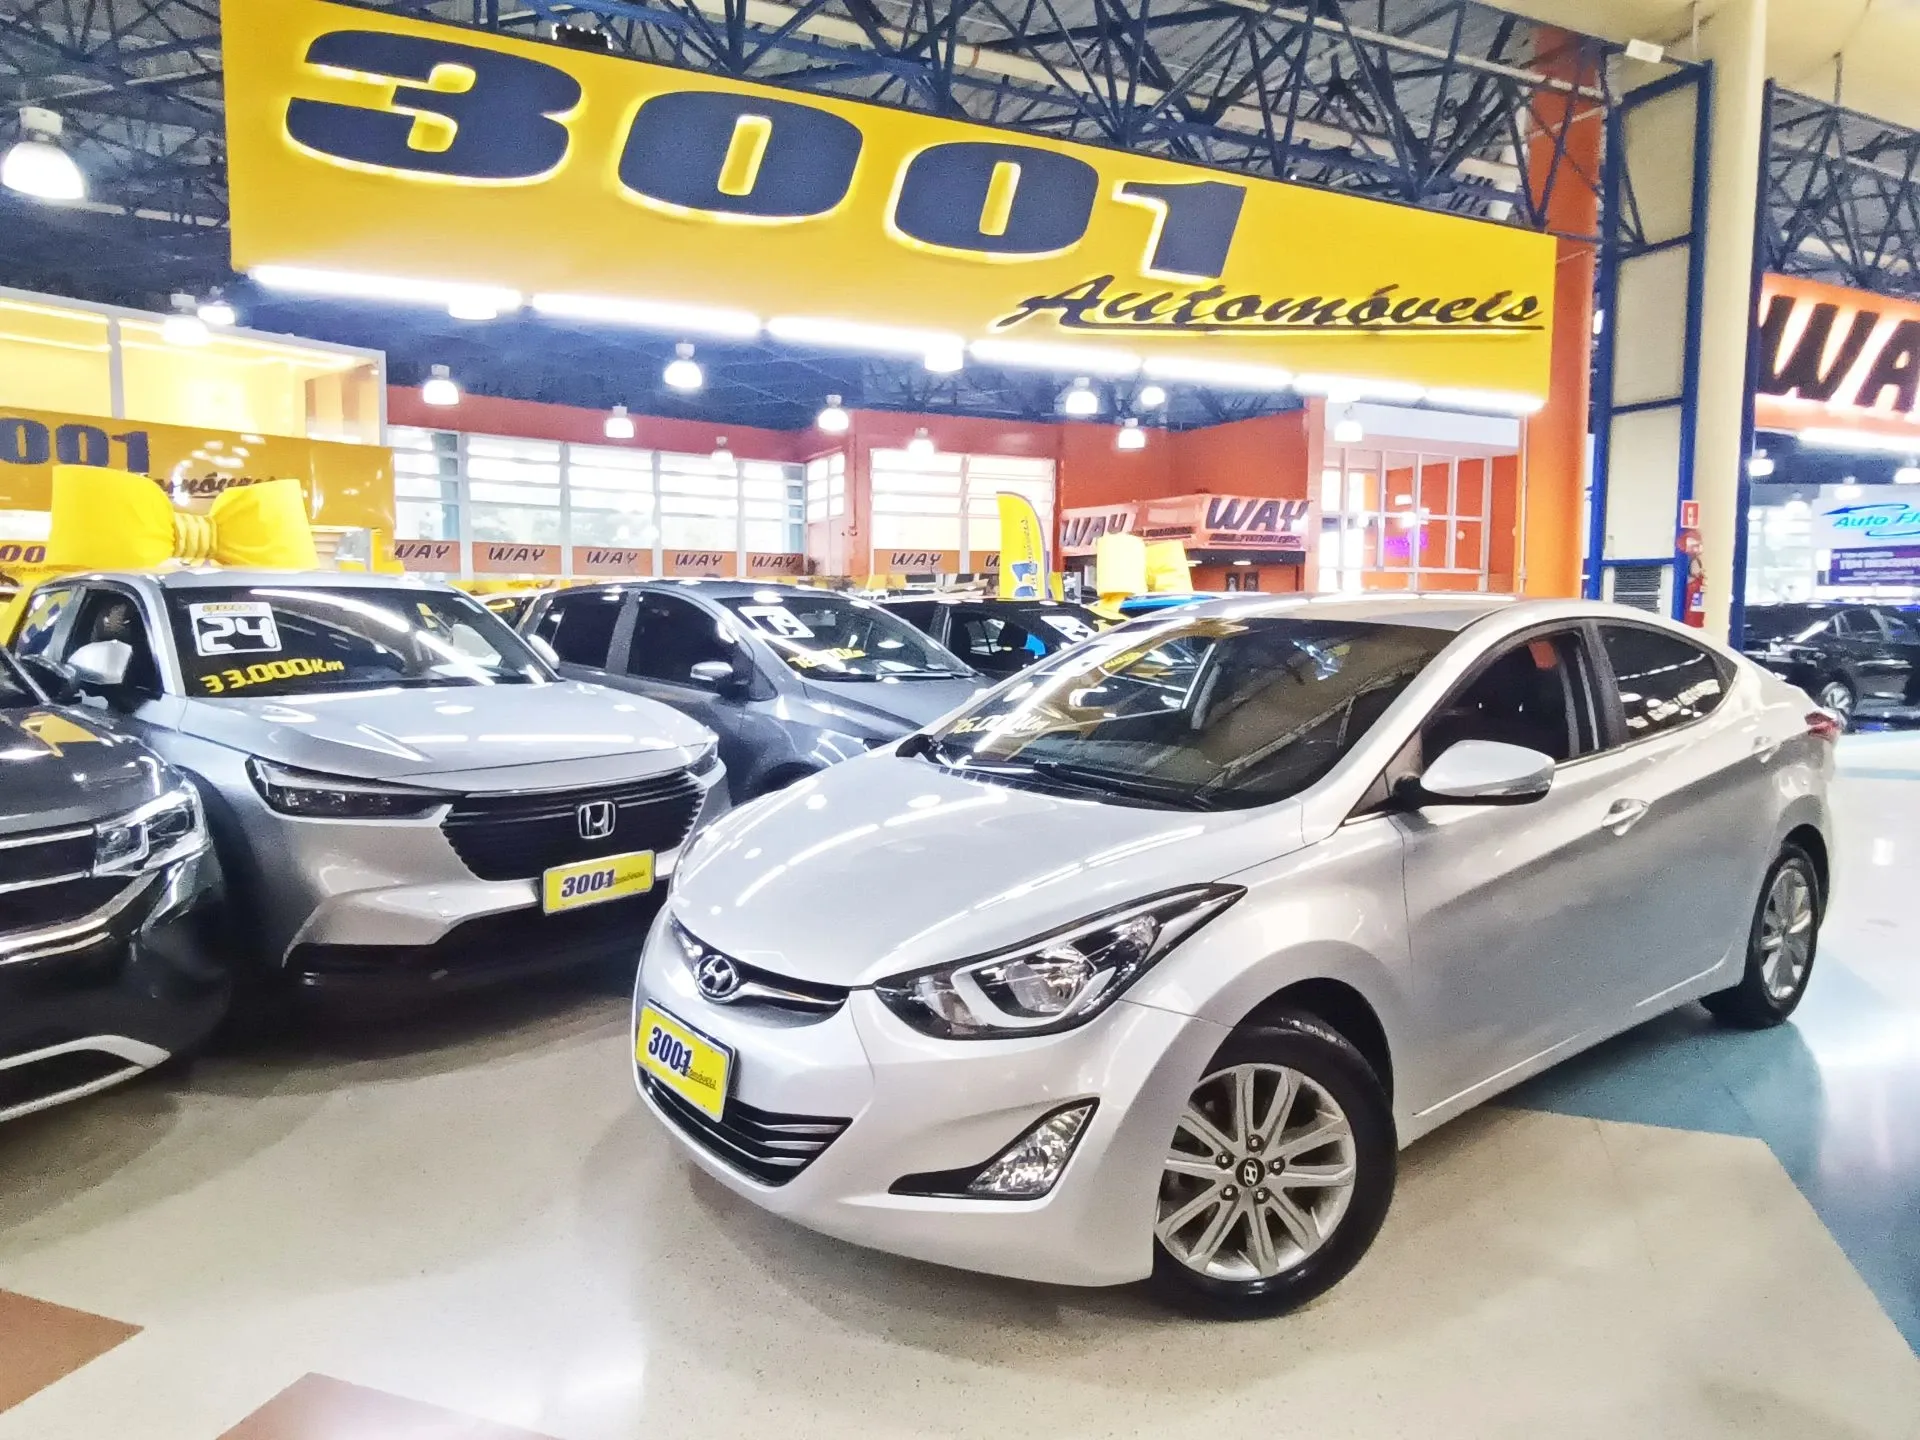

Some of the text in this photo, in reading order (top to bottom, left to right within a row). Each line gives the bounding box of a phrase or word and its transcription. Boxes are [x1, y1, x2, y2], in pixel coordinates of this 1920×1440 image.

[286, 30, 1248, 278] 3001
[996, 274, 1544, 328] Automóveis
[1205, 497, 1310, 532] WAY
[1833, 514, 1889, 527] Auto
[394, 544, 450, 559] WAY
[487, 547, 546, 561] WAY
[586, 551, 638, 564] WAY
[675, 553, 723, 567] WAY
[752, 555, 797, 568] WAY
[890, 552, 942, 567] WAY
[201, 616, 277, 651] 24
[561, 868, 616, 898] 3001
[648, 1026, 693, 1074] 3001
